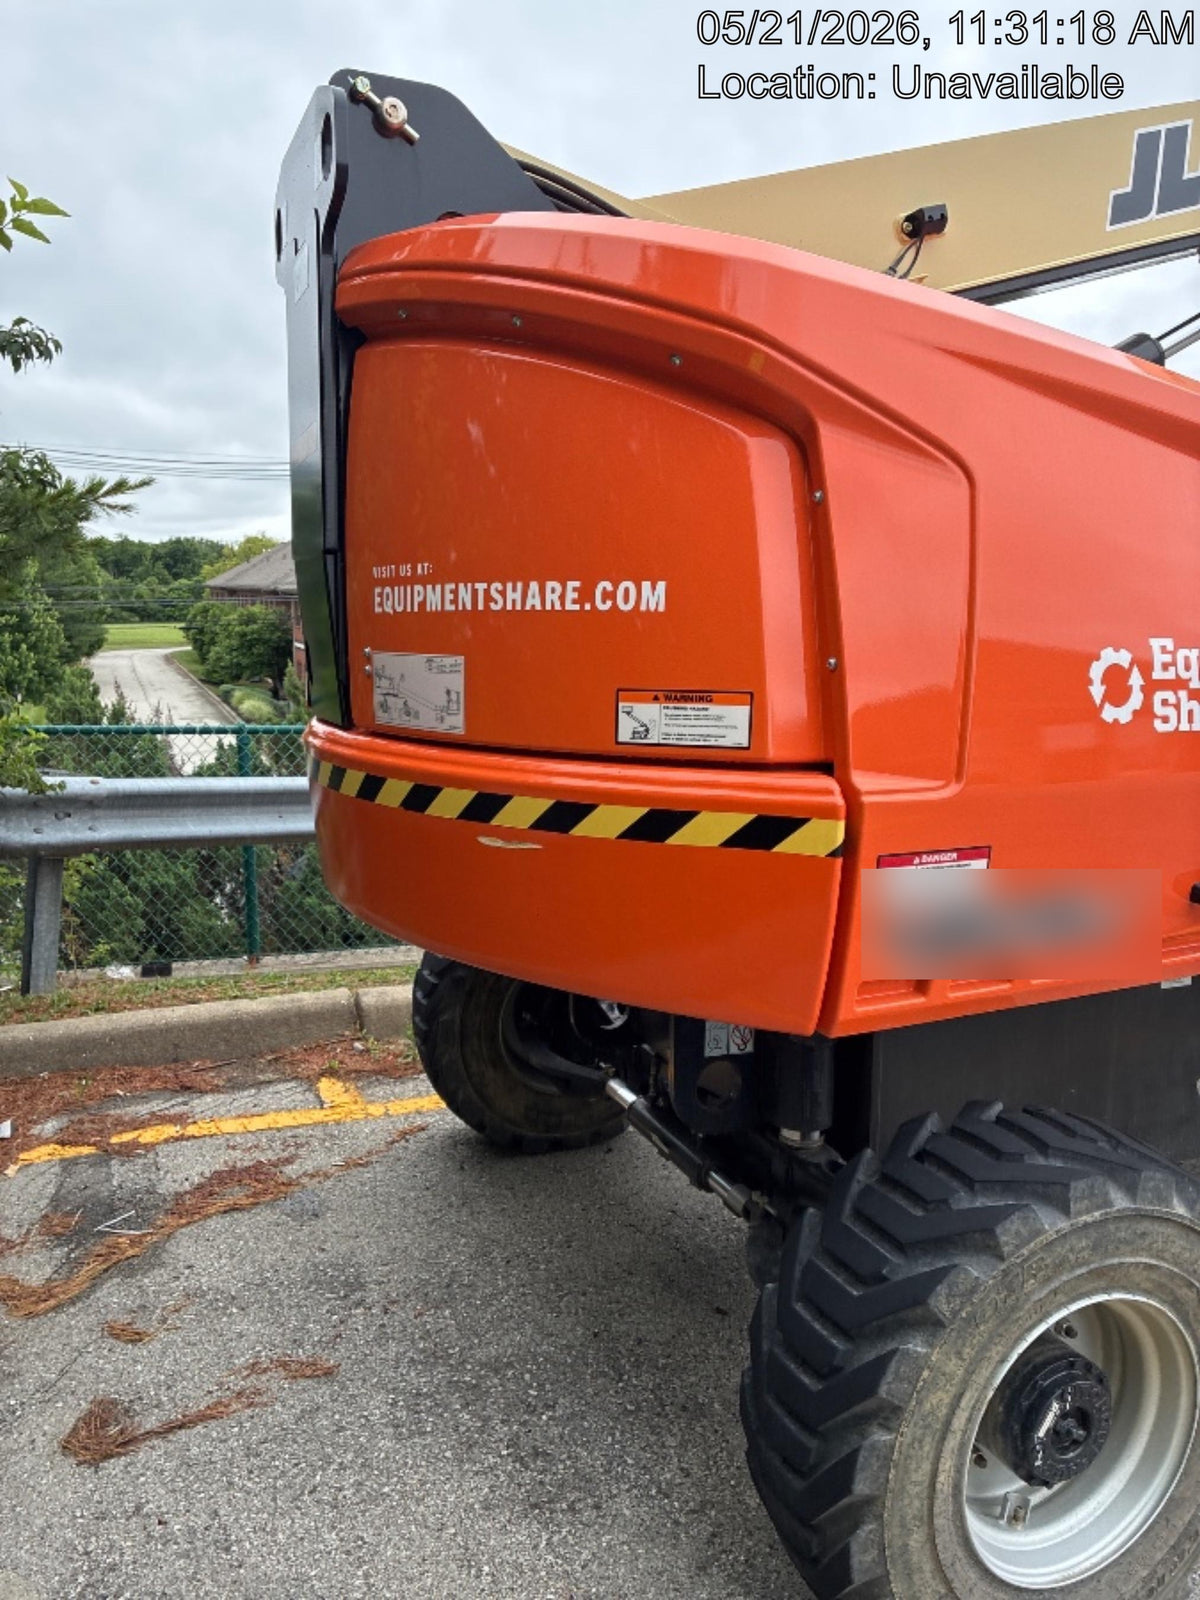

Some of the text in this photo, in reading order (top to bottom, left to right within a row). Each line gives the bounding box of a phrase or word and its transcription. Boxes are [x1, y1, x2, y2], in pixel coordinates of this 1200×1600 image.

[372, 562, 433, 579] VISIT US AT:
[374, 580, 667, 615] EQUIPMENTSHARE.COM
[663, 693, 713, 703] WARNING
[921, 852, 958, 863] DANGER
